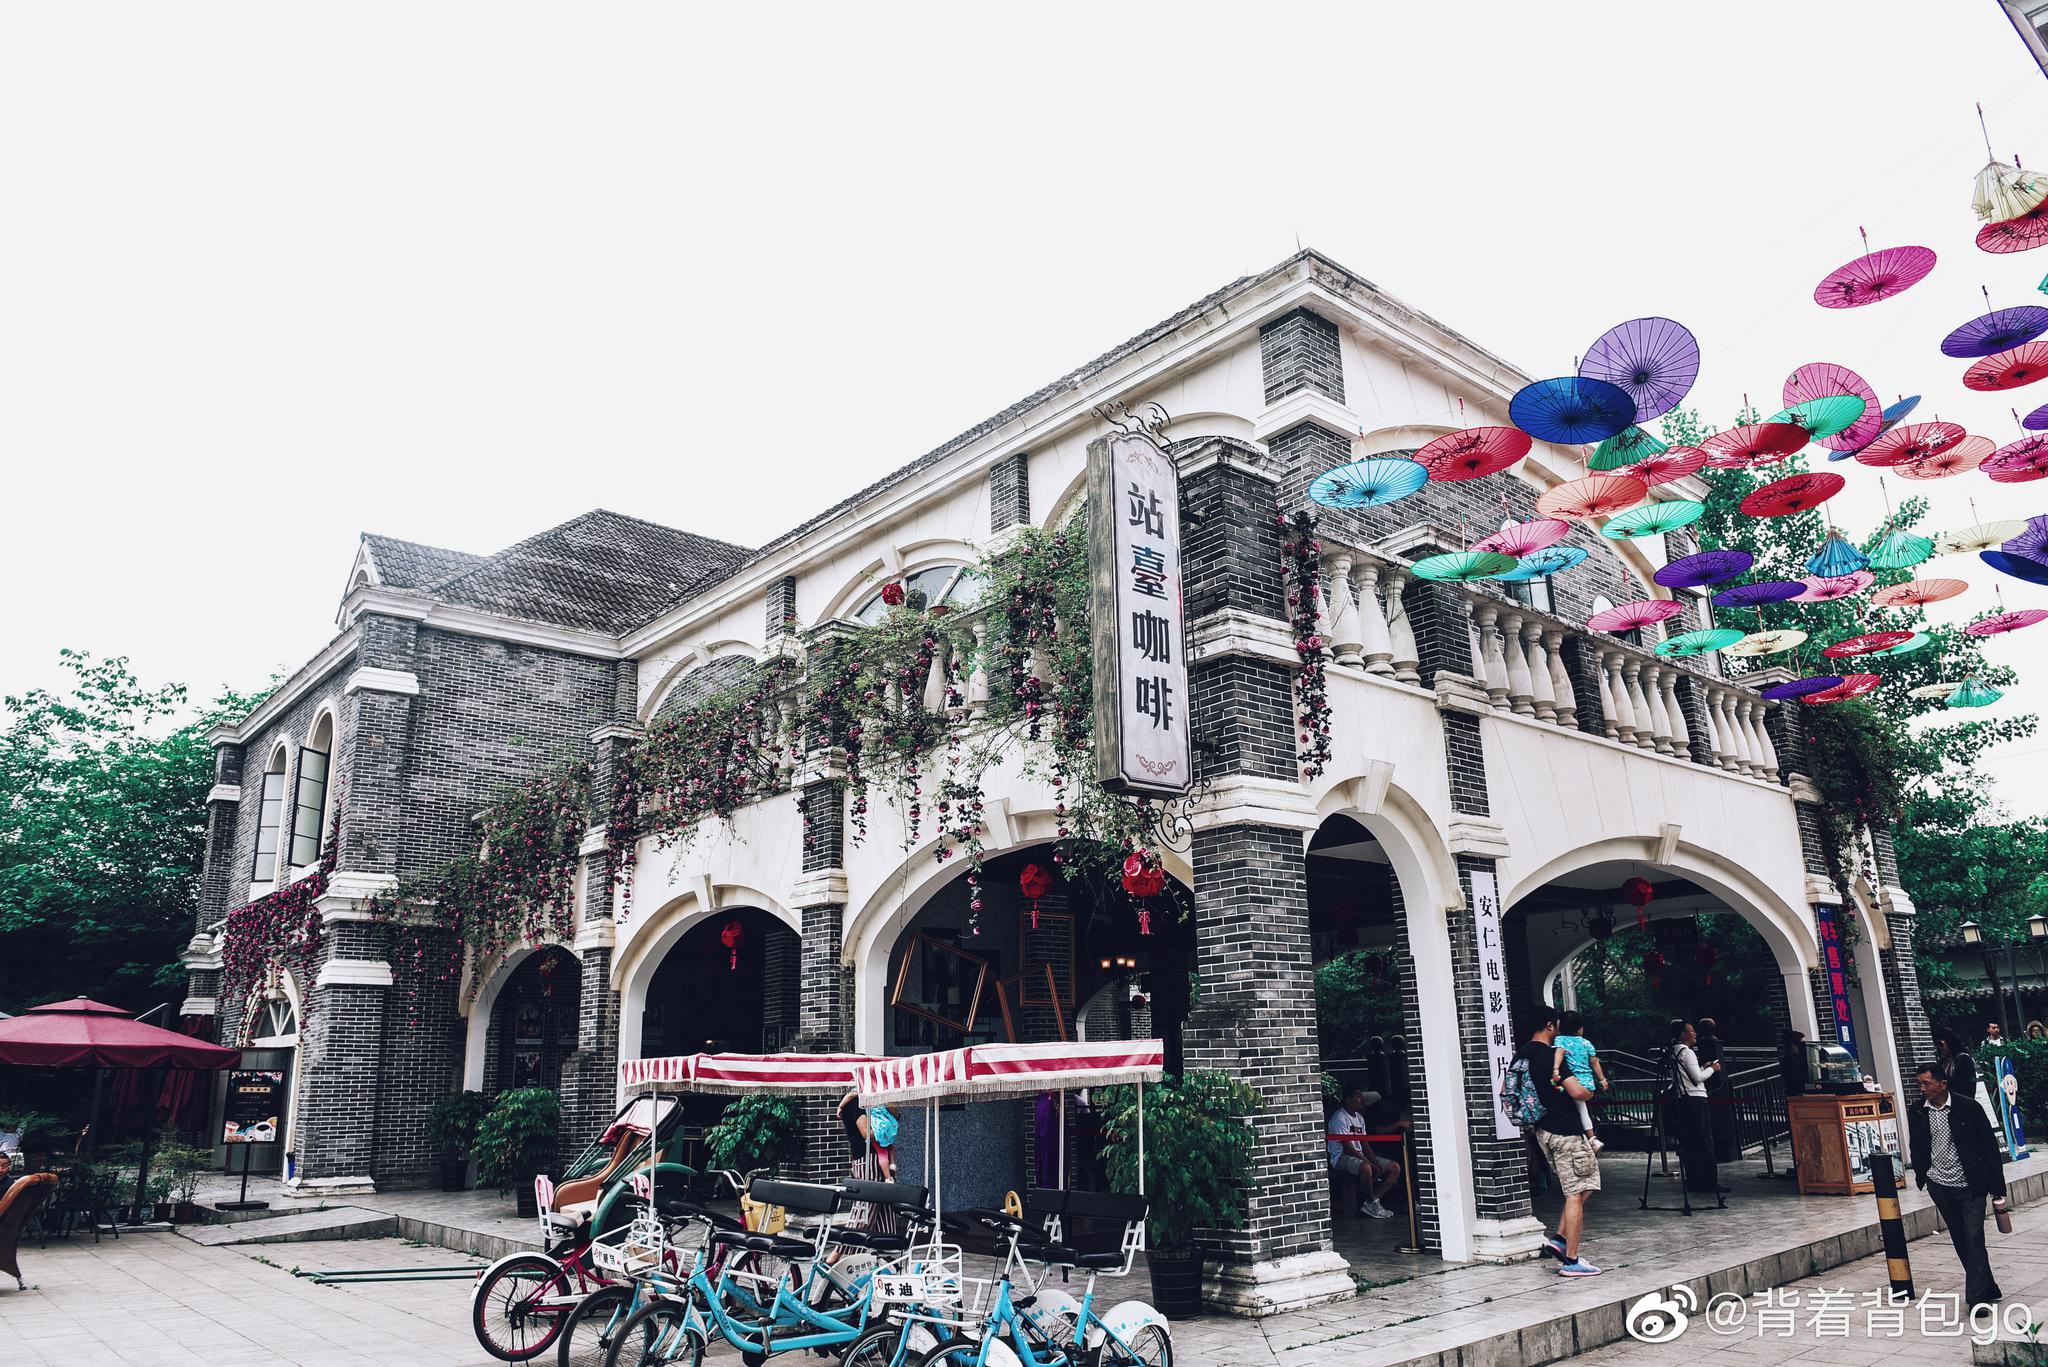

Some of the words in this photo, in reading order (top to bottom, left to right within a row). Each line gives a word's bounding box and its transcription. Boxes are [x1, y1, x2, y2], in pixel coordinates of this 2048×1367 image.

[1127, 481, 1174, 731] 站臺咖啡
[1479, 895, 1509, 1114] 安仁电影制片
[884, 1282, 914, 1297] 乐迪
